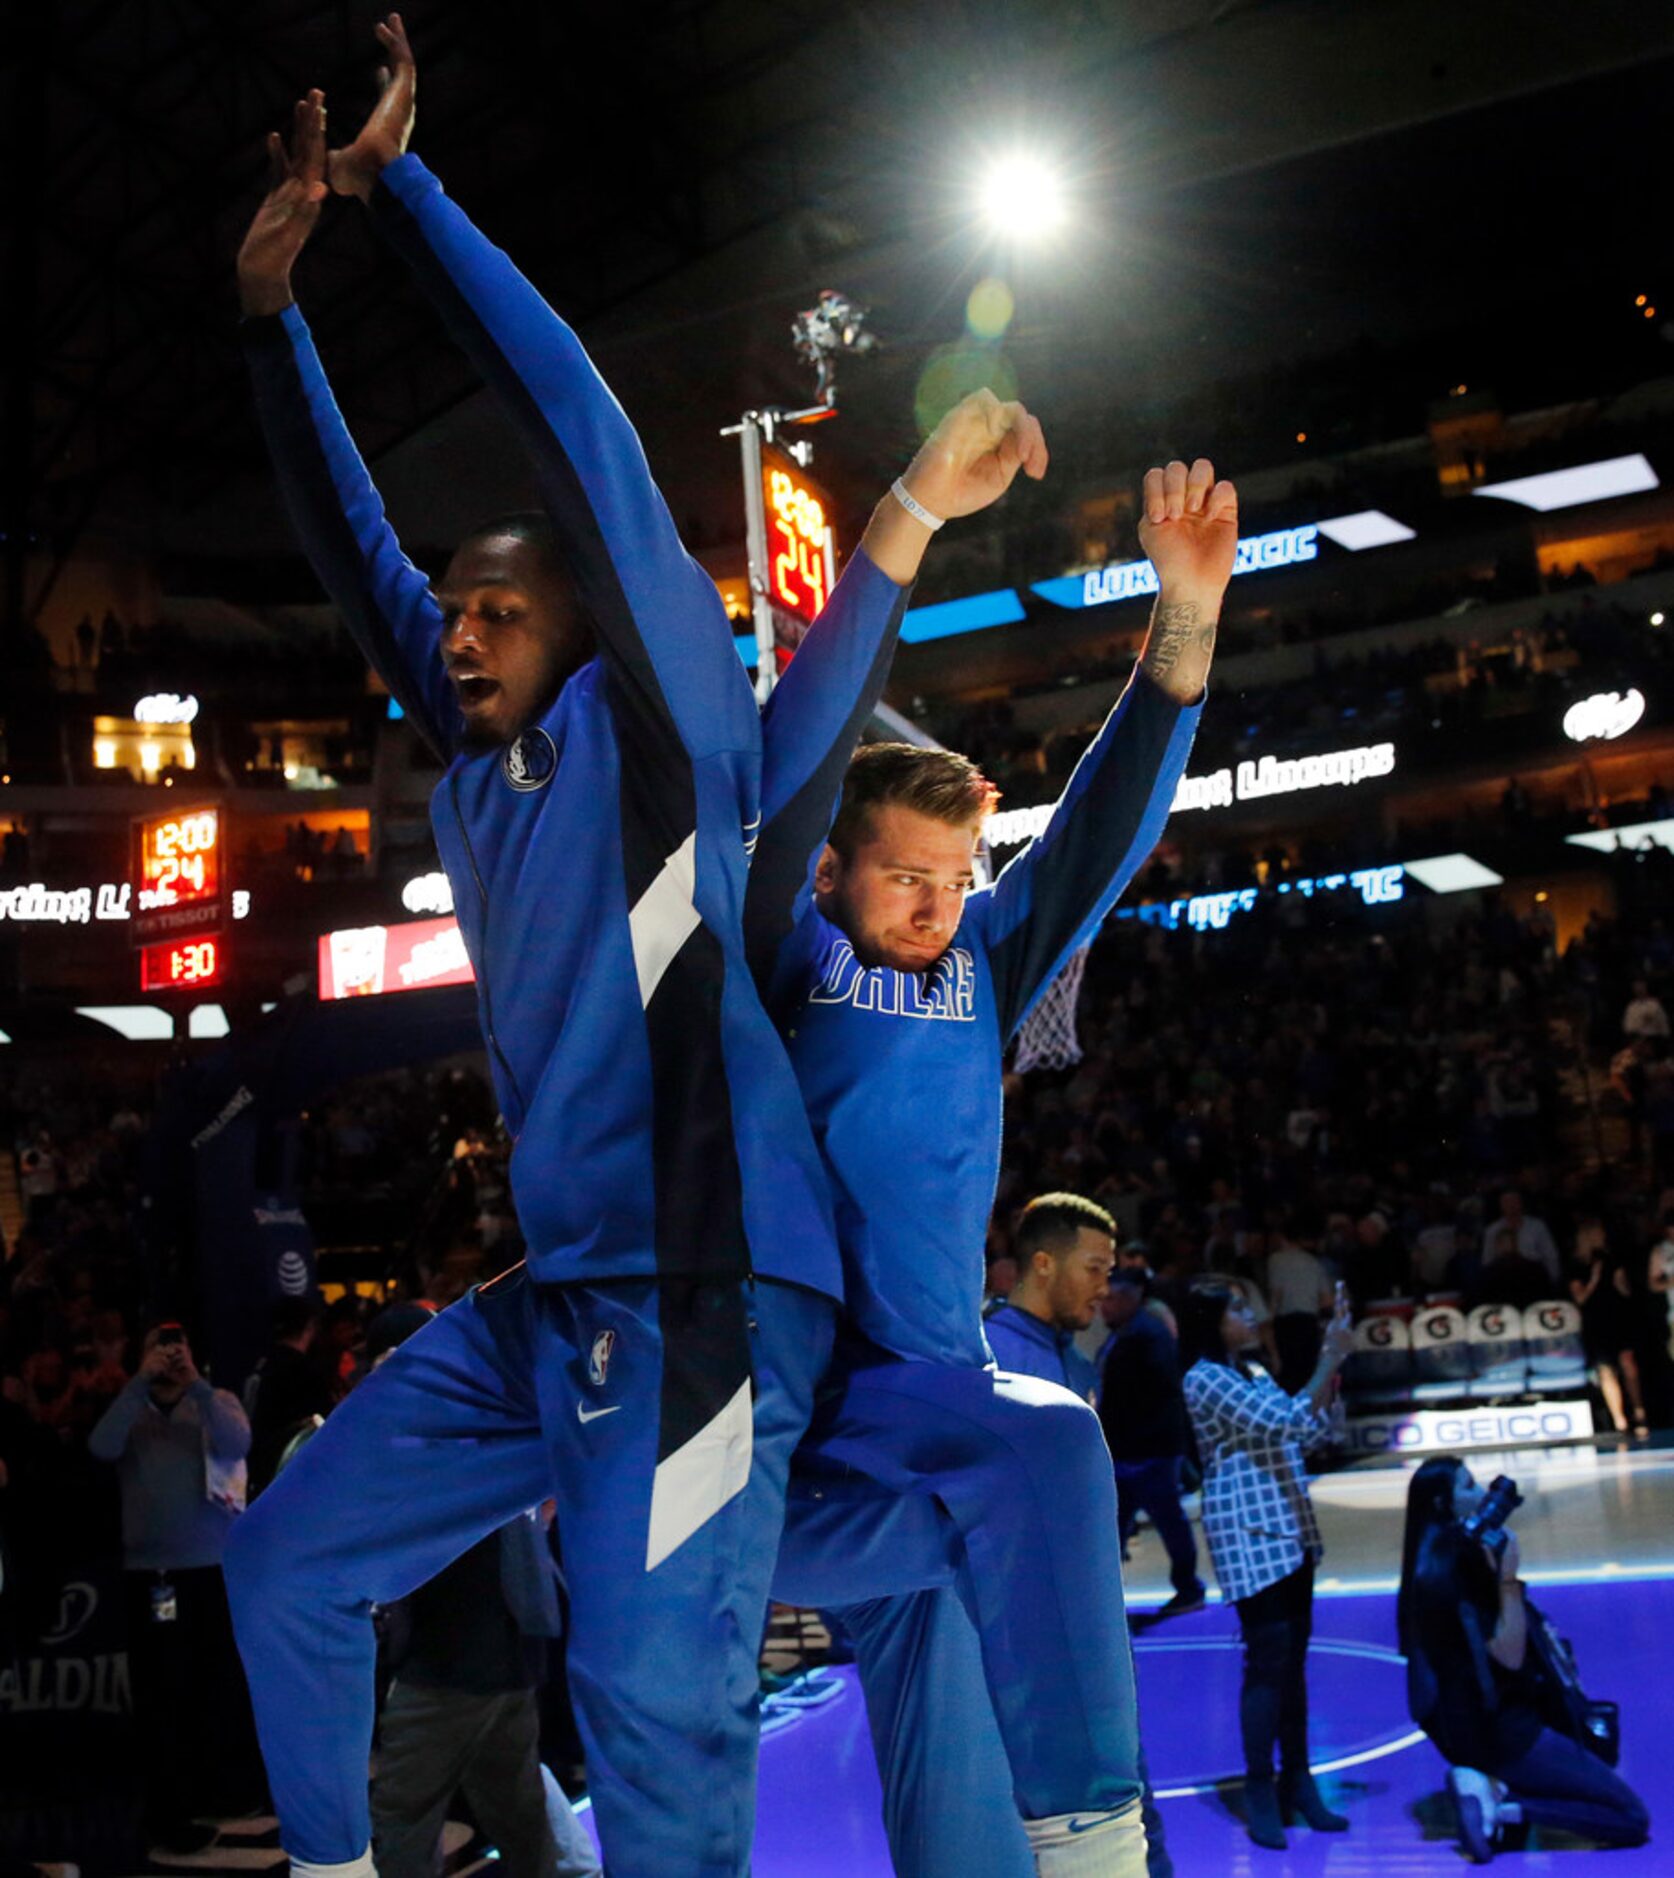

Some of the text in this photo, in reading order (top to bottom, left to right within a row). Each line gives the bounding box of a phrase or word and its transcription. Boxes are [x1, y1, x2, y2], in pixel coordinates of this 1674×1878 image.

[775, 518, 825, 619] 24
[156, 815, 215, 857] 12:00
[159, 854, 205, 894] 24
[159, 904, 220, 931] TISSOT
[171, 942, 215, 980] 1:30
[1425, 1313, 1452, 1340] G
[1481, 1309, 1506, 1337] G
[1539, 1306, 1565, 1332] G
[1350, 1412, 1573, 1449] ICO GEICO
